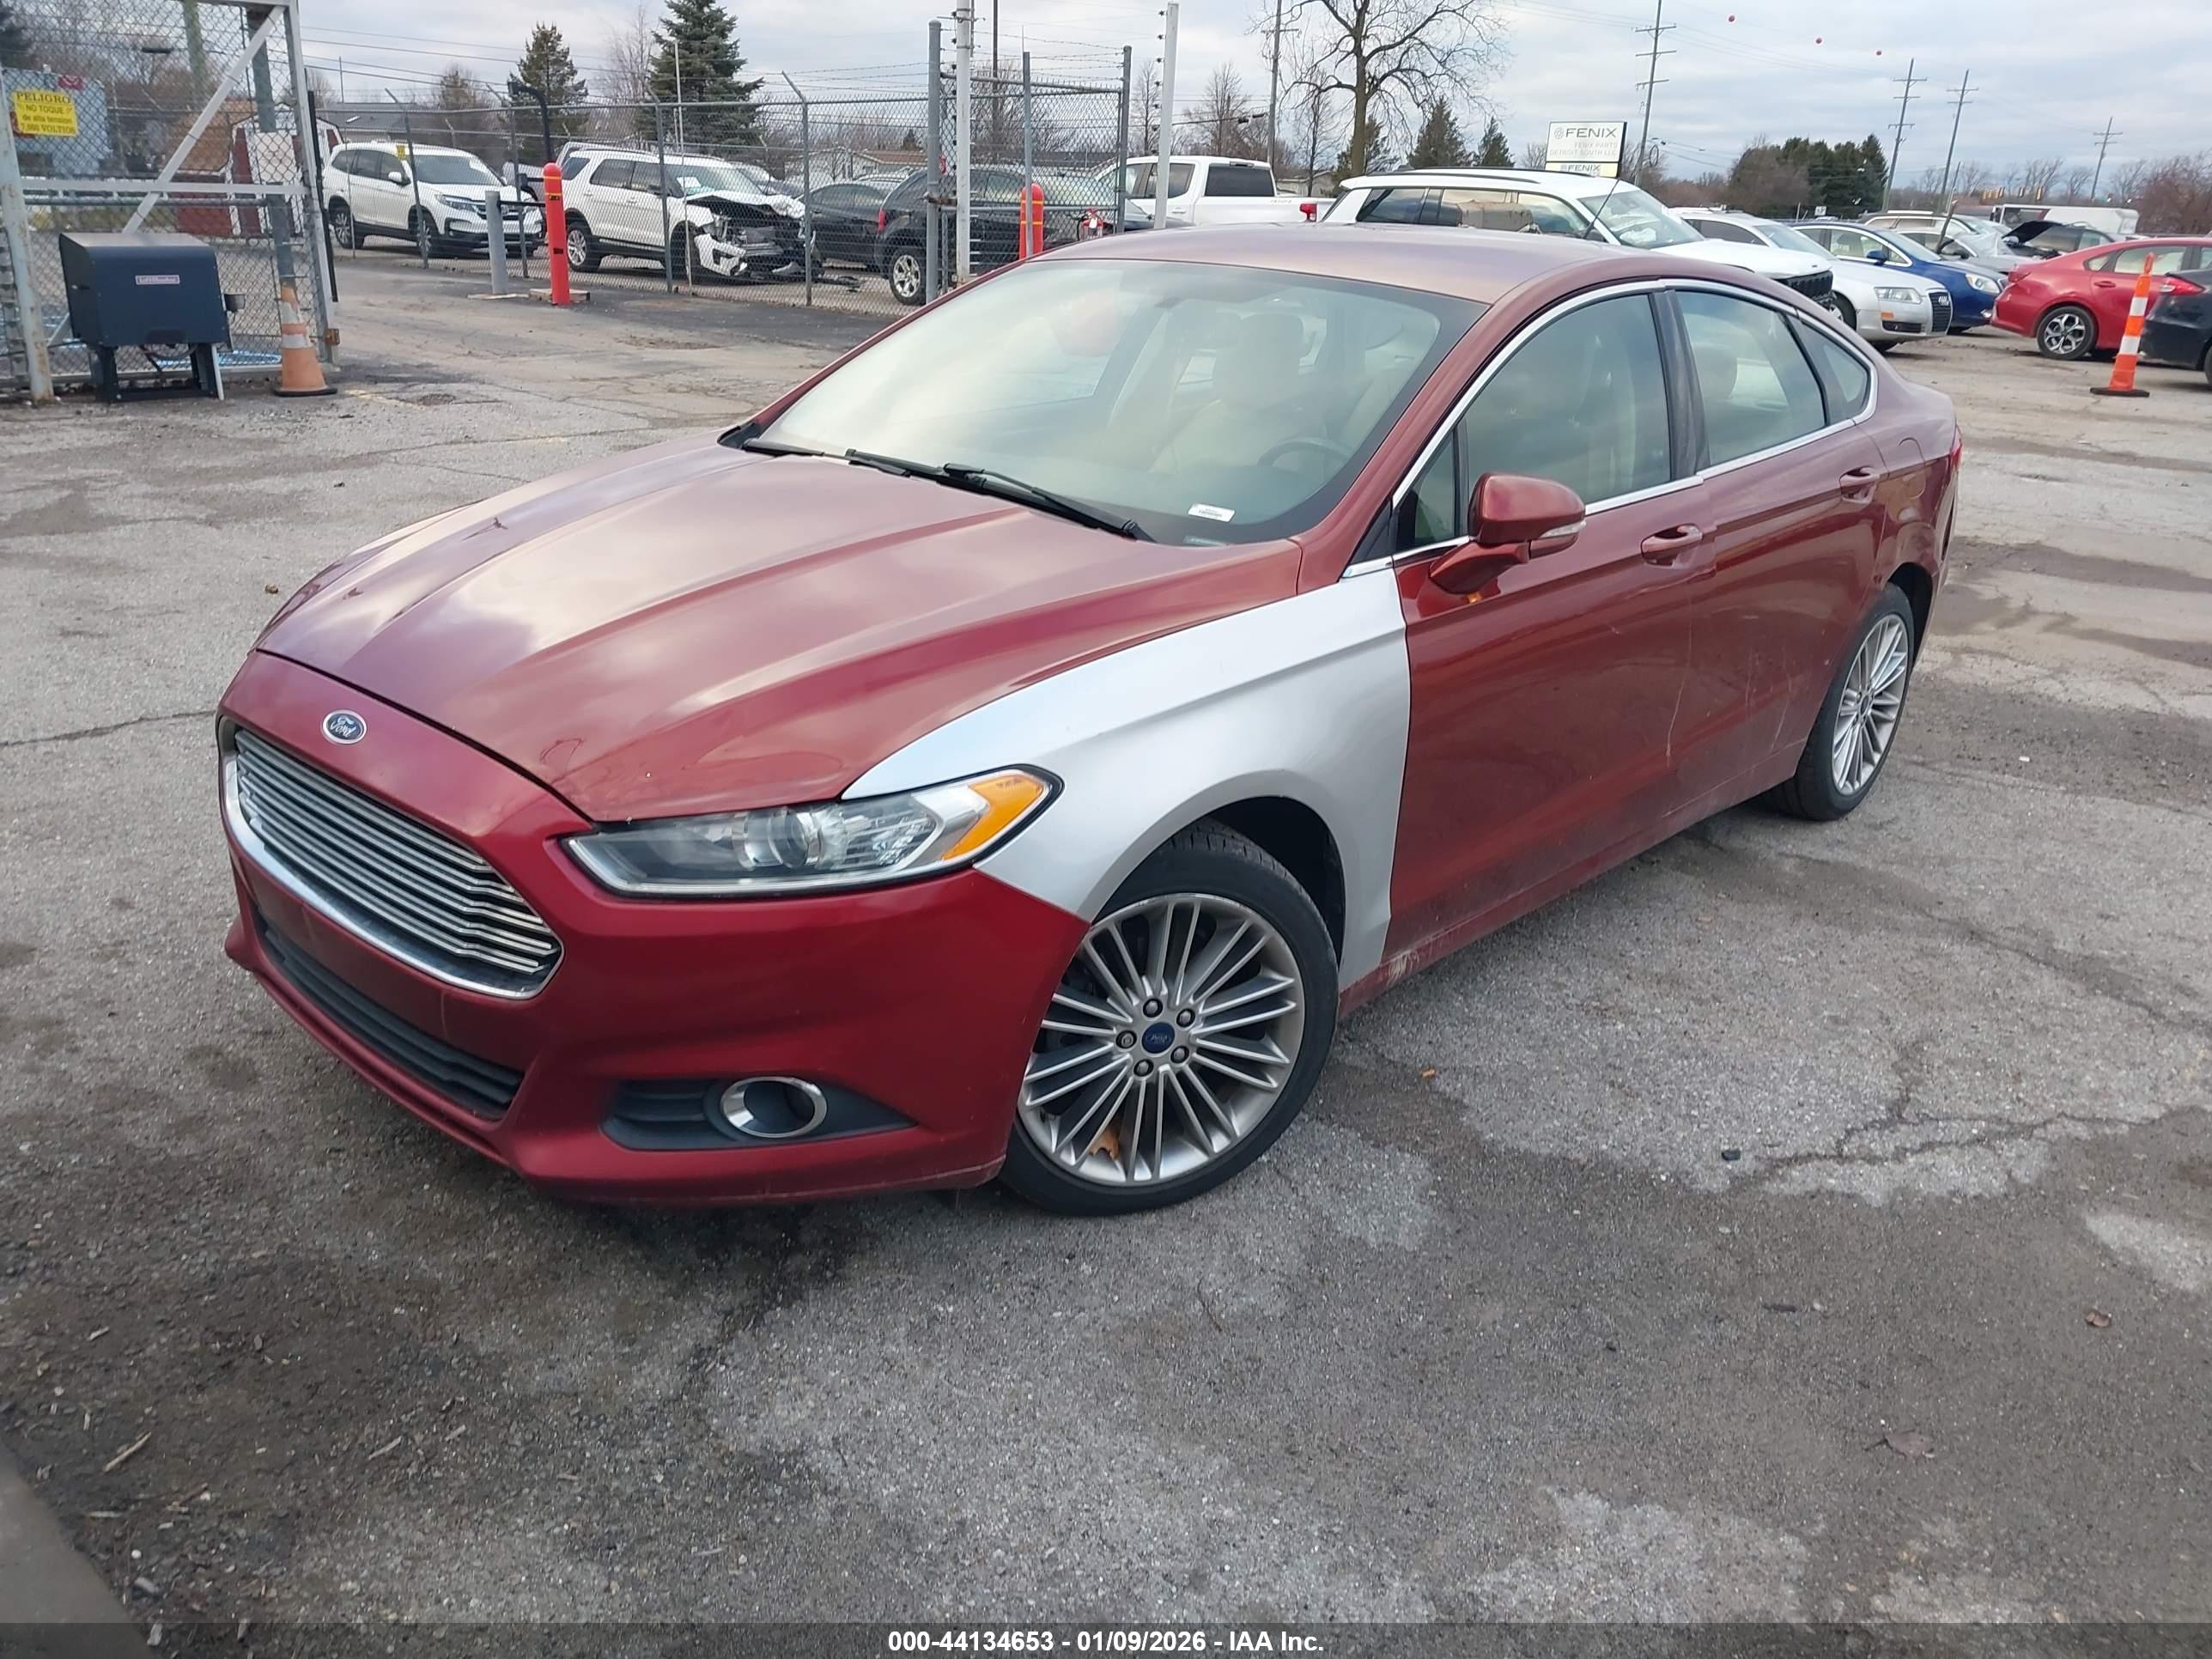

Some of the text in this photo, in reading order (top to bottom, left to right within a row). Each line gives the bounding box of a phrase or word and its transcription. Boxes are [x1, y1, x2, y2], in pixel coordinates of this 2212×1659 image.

[16, 92, 71, 104] PELIGRO
[39, 105, 64, 114] TOQUE
[1565, 127, 1617, 138] FENIX
[1567, 164, 1601, 173] FENIX
